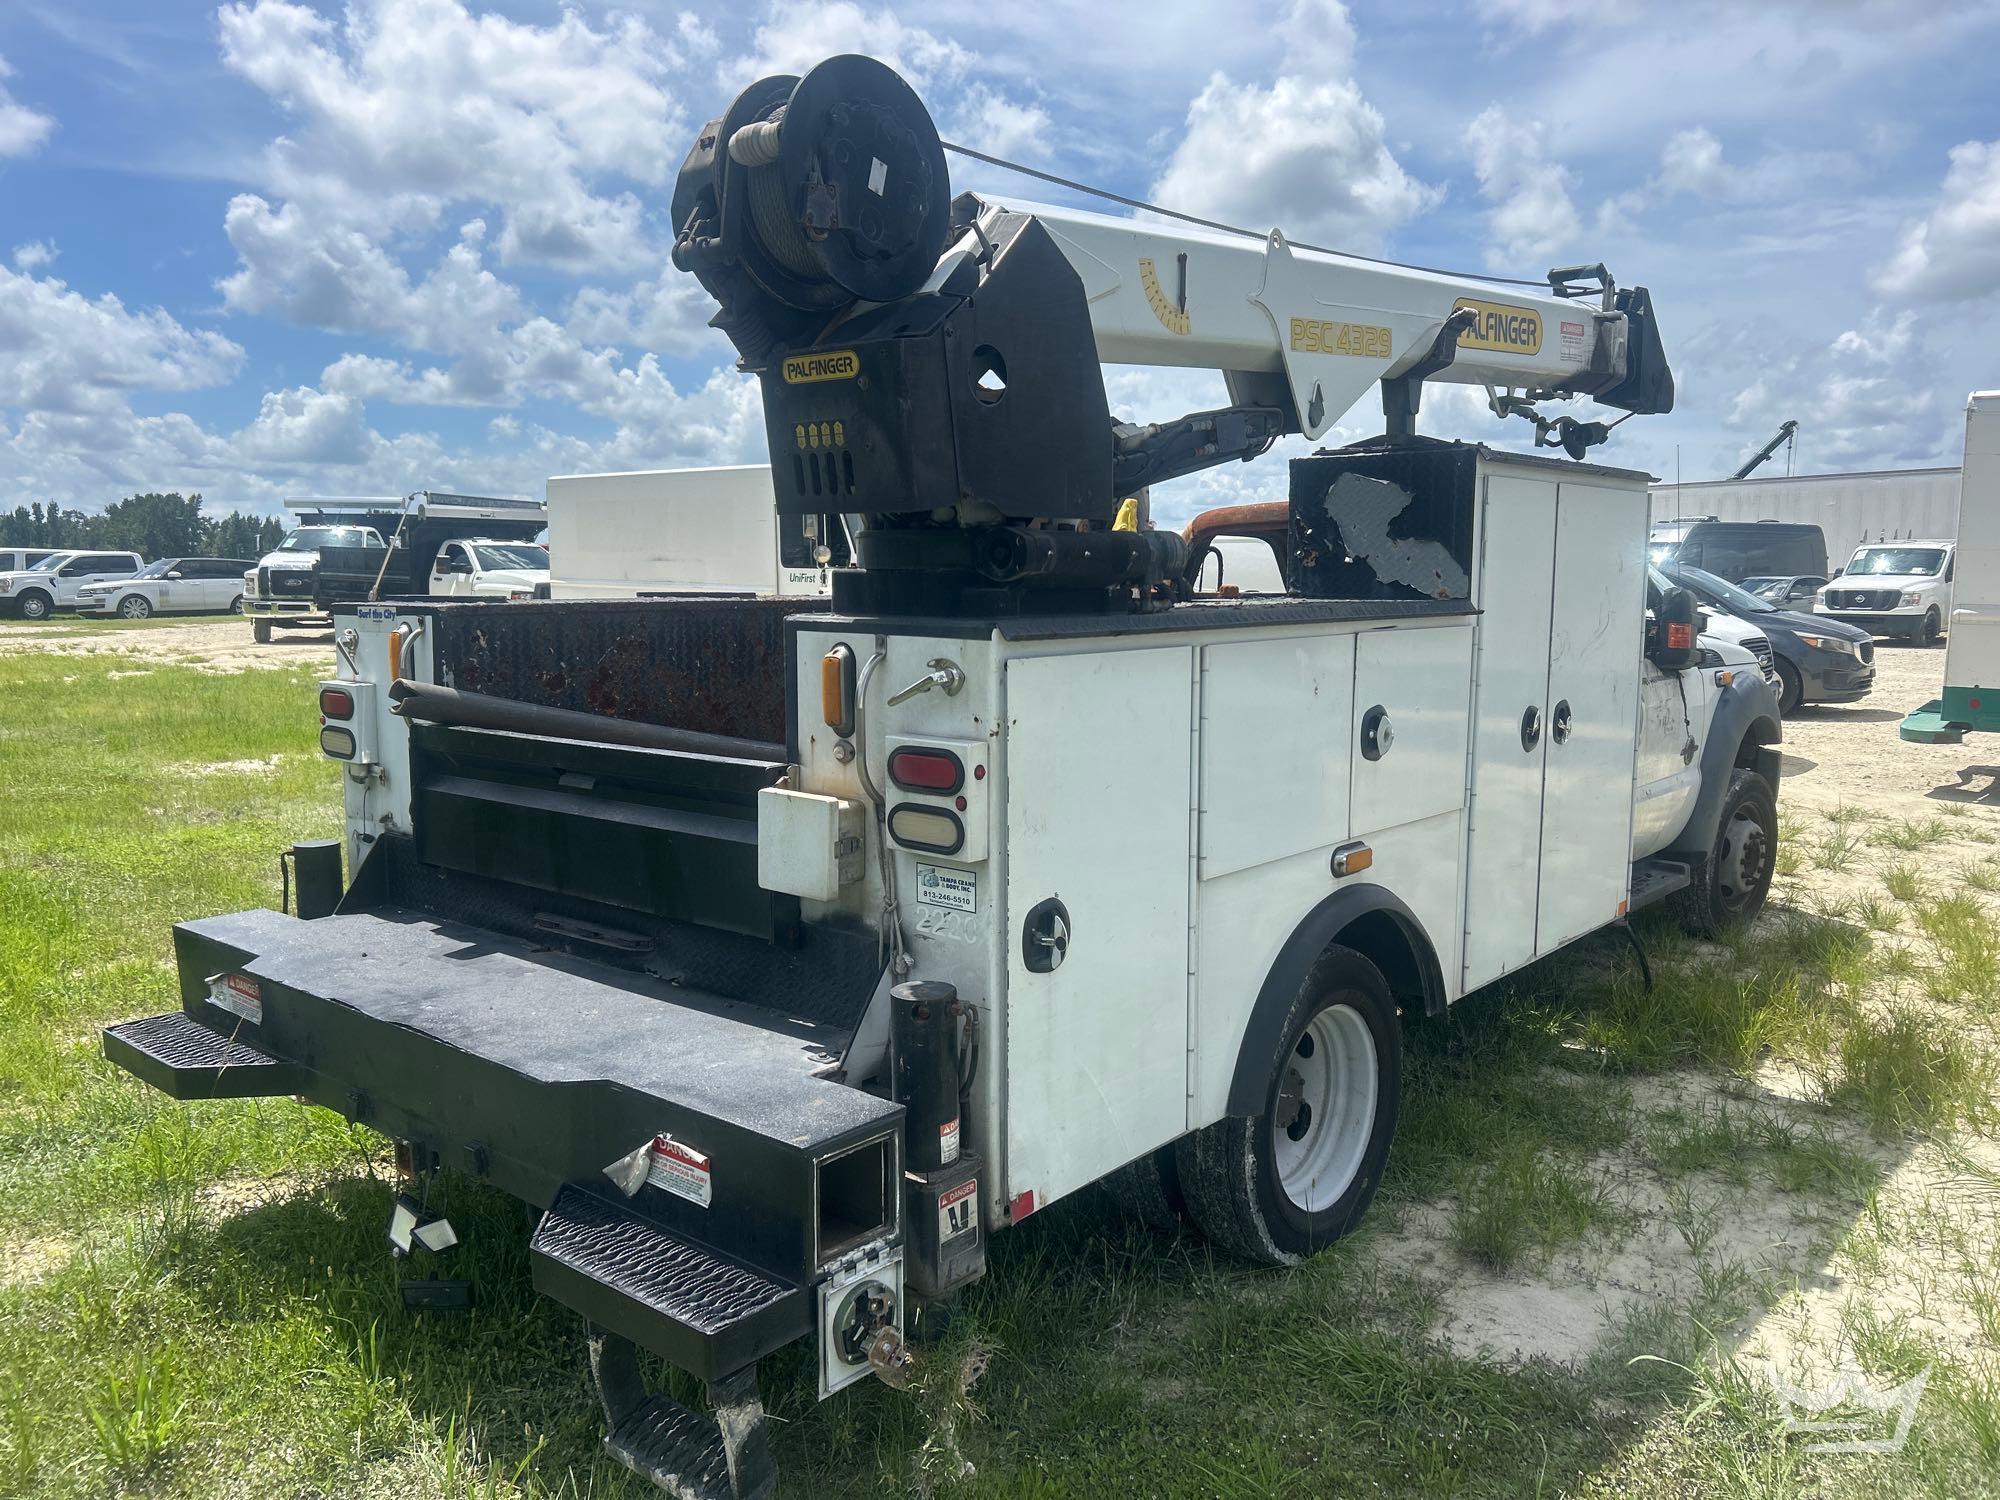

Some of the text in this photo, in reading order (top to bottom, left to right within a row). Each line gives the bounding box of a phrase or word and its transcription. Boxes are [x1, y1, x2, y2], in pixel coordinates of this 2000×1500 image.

[1459, 310, 1537, 346] ALFINGER
[1290, 318, 1392, 358] PSC 4329
[787, 356, 853, 379] PALFINGER
[789, 573, 816, 583] UniFirst
[358, 608, 396, 621] Surf the City
[940, 876, 975, 888] TAMPA CRANE
[946, 883, 960, 891] BODY,
[923, 890, 970, 905] 813-246-5510
[950, 1183, 975, 1201] DANGER
